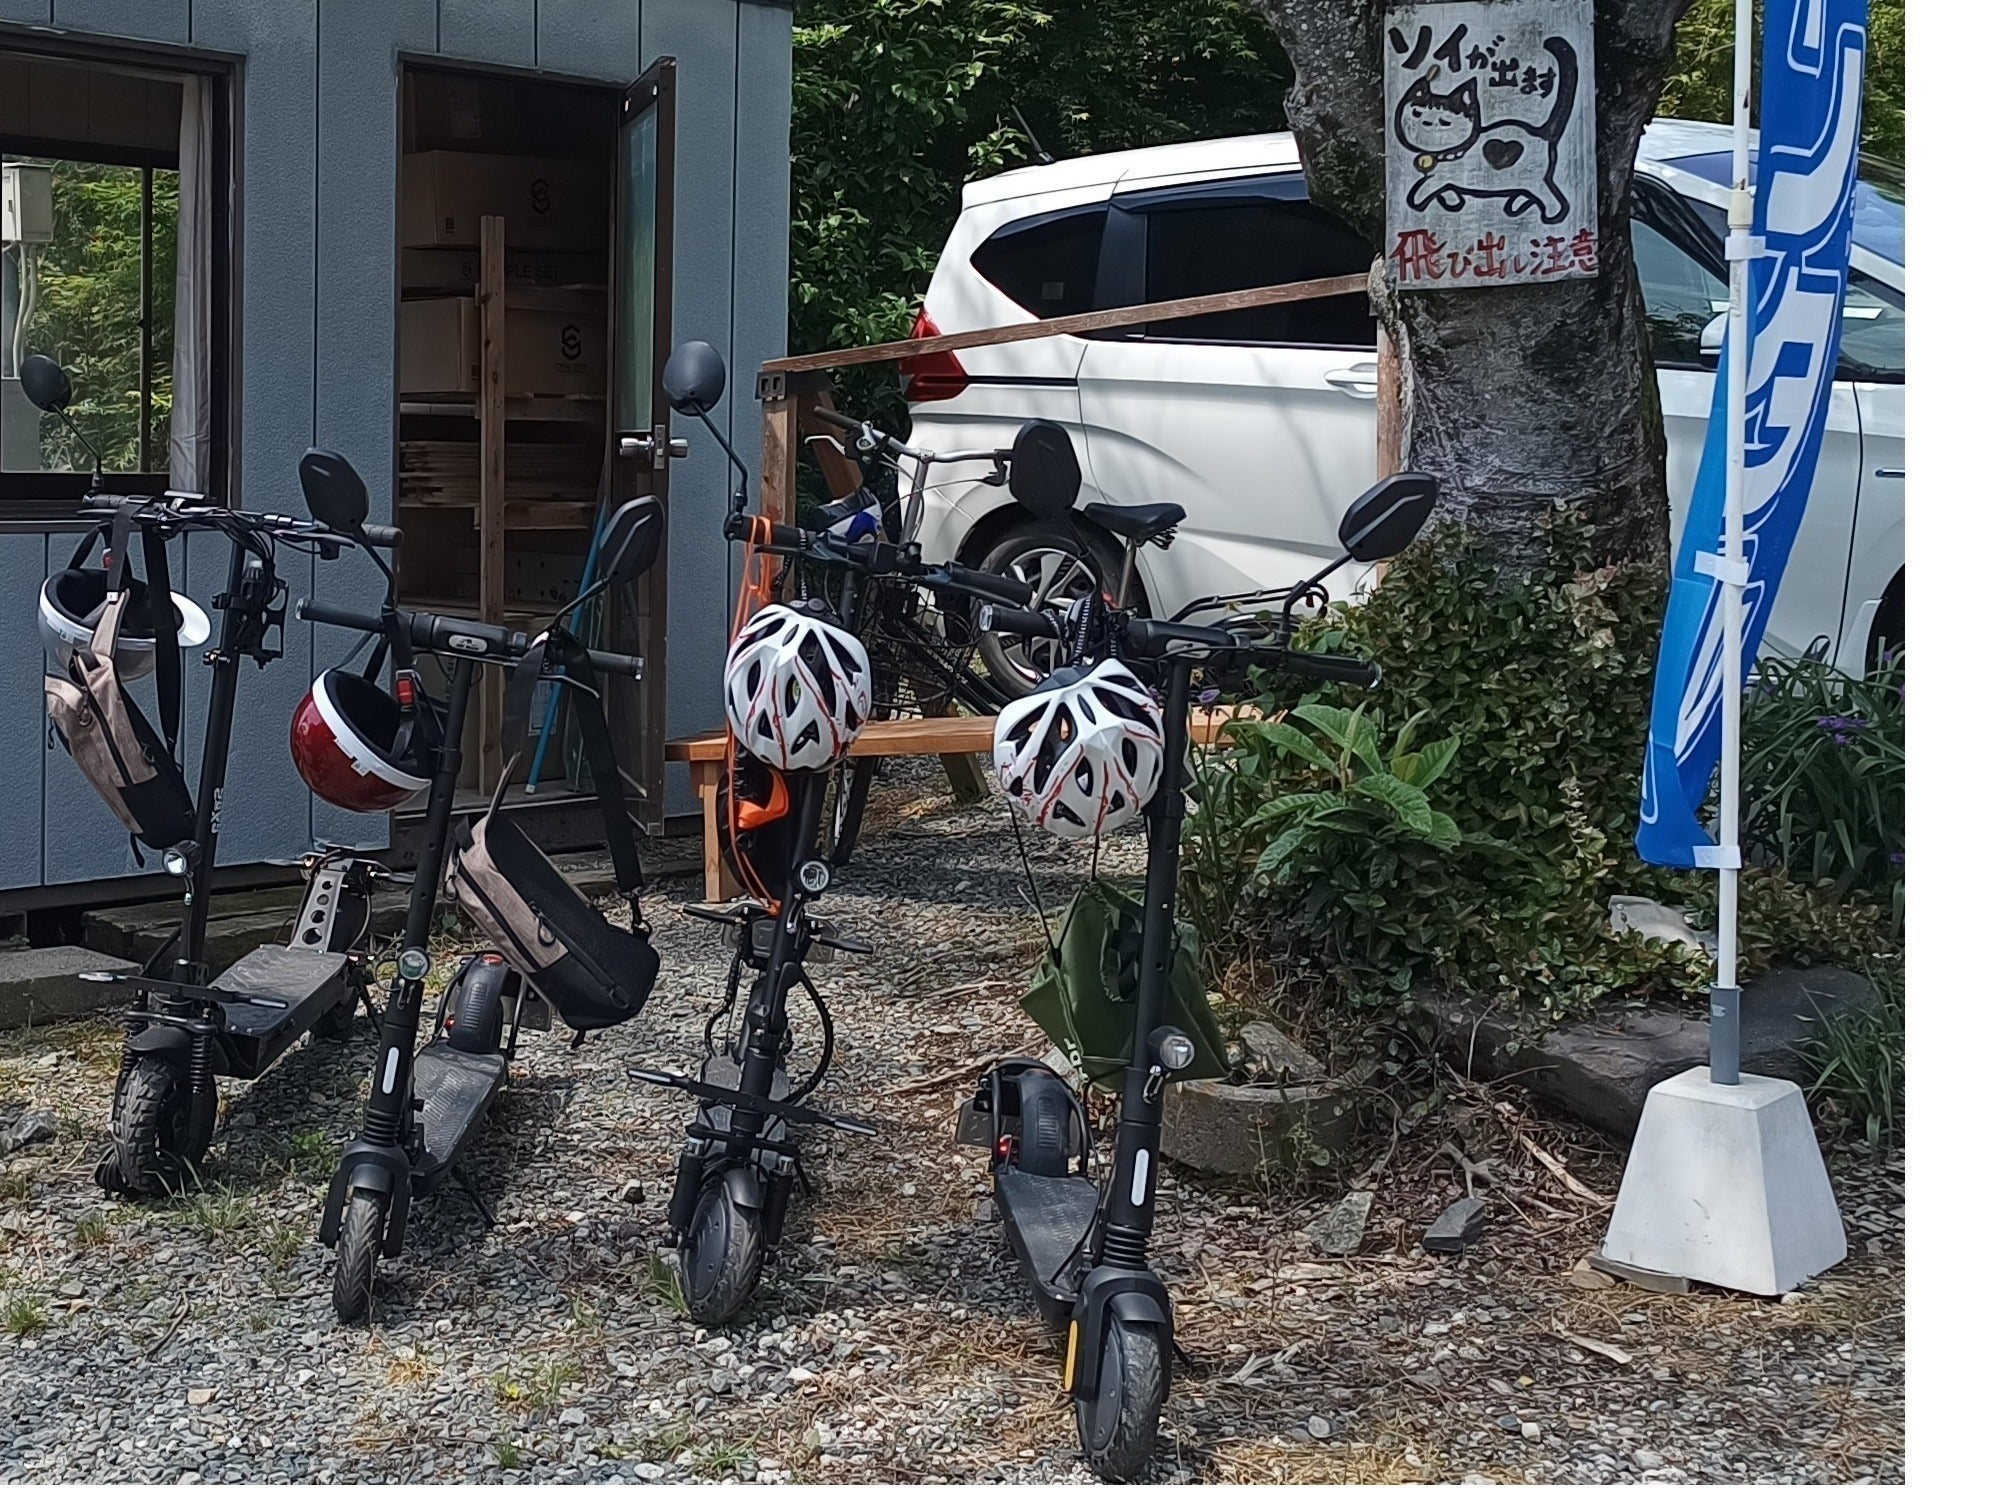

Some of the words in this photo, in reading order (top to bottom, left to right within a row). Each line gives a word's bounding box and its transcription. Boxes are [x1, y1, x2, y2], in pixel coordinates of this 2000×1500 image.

[1388, 23, 1556, 99] ソイが出ます
[1389, 228, 1599, 281] 飛び出し注意
